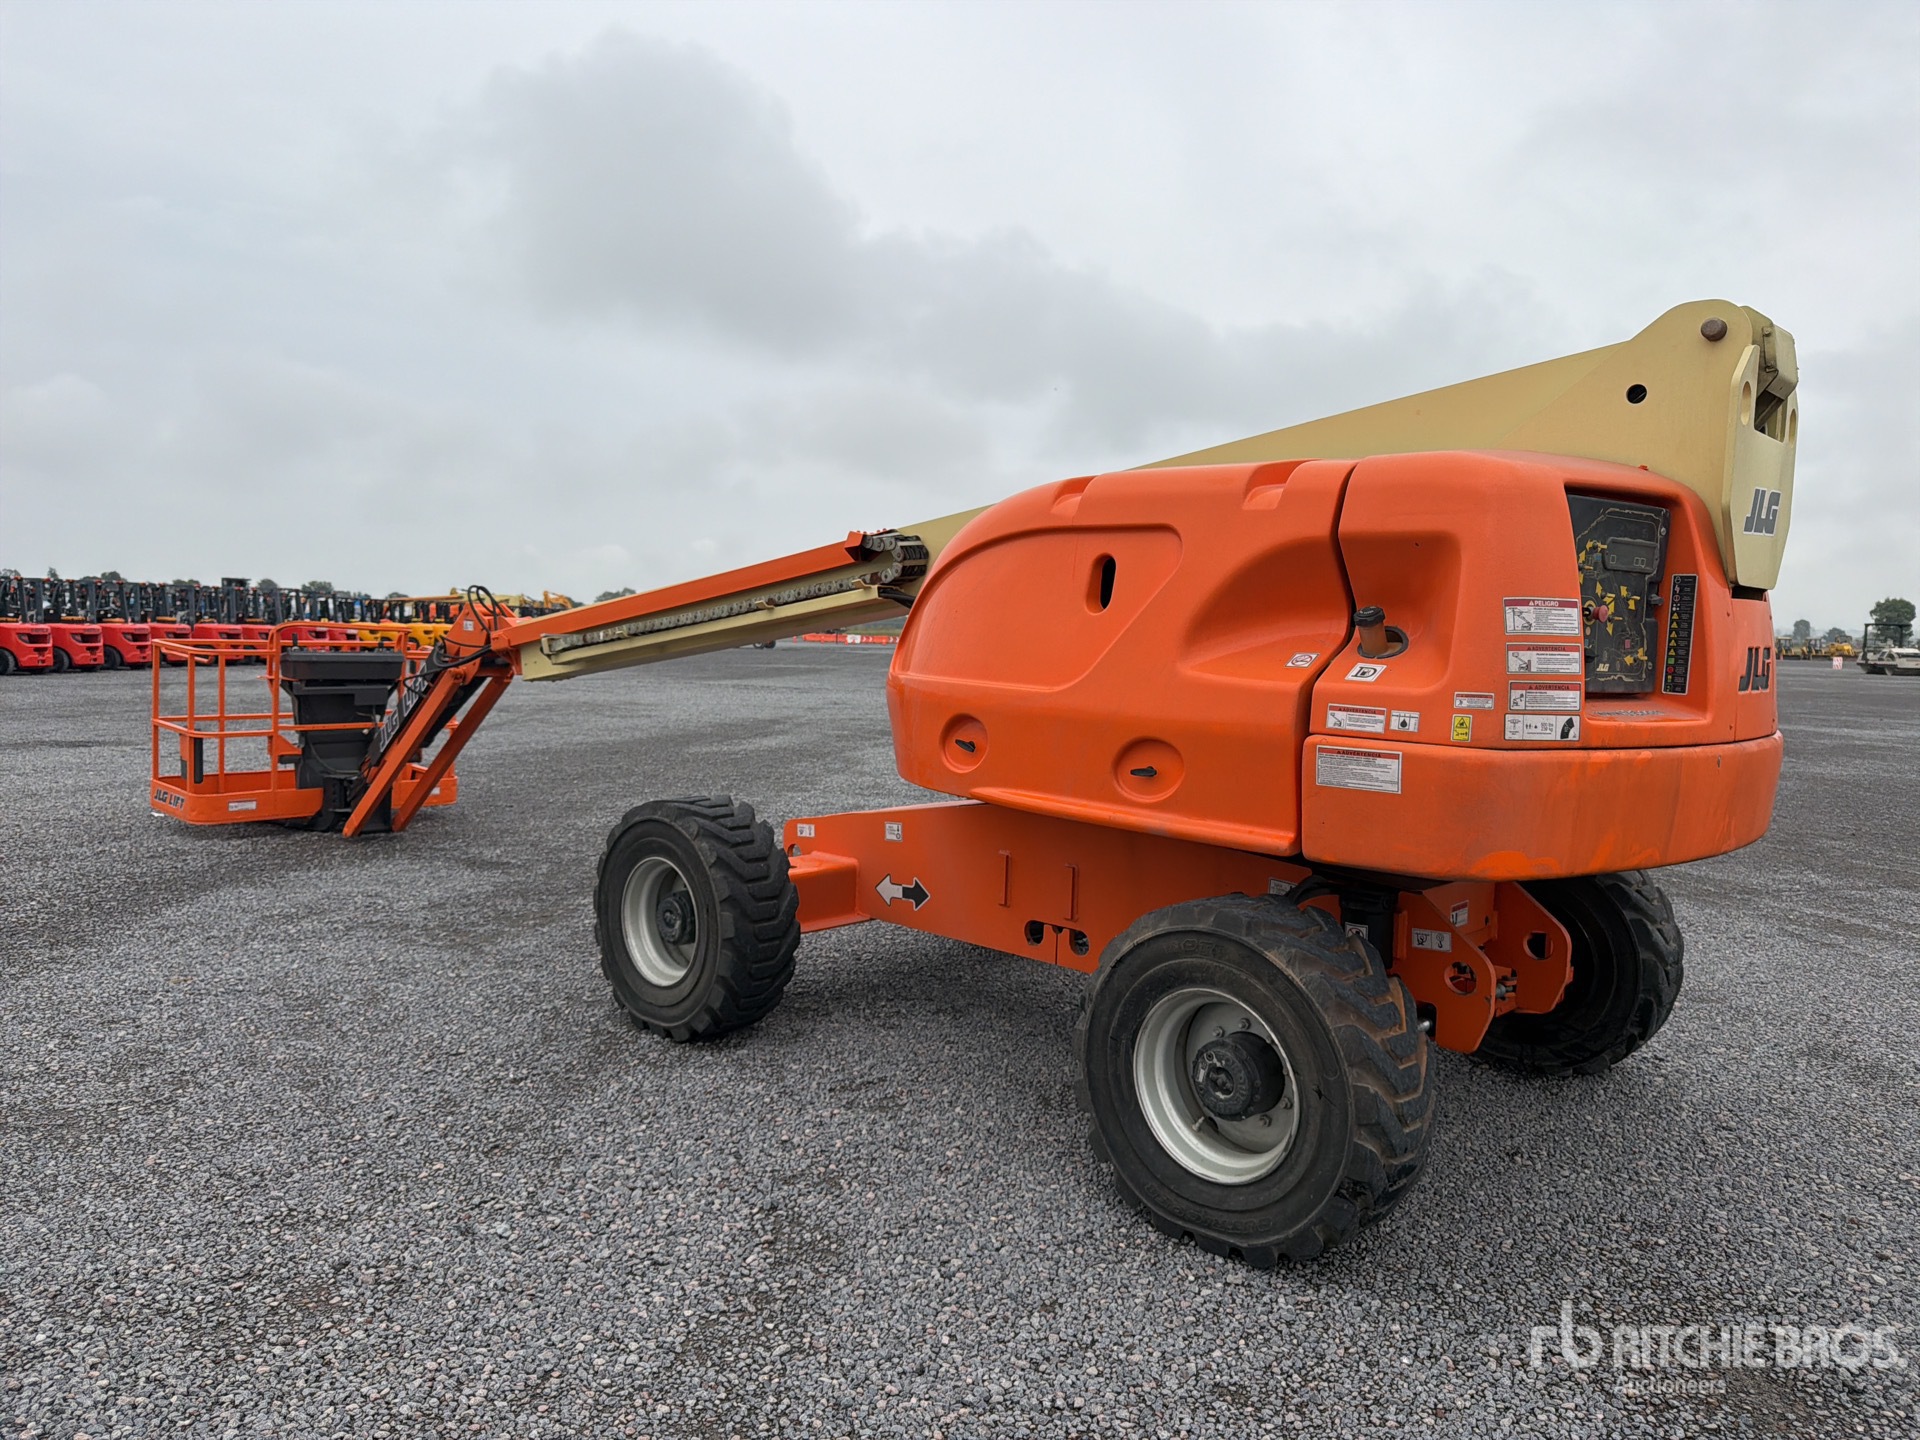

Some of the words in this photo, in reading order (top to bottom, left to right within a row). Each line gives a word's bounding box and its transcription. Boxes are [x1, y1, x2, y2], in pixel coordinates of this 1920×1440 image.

[1743, 487, 1782, 536] JLG
[1597, 663, 1609, 672] JLG
[1738, 647, 1772, 693] JLG
[1342, 707, 1377, 715] ADVERTENCIA
[379, 709, 399, 752] JLG
[1342, 750, 1382, 758] ADVERTENCIA
[153, 788, 168, 804] JLG
[168, 793, 185, 810] LIFT
